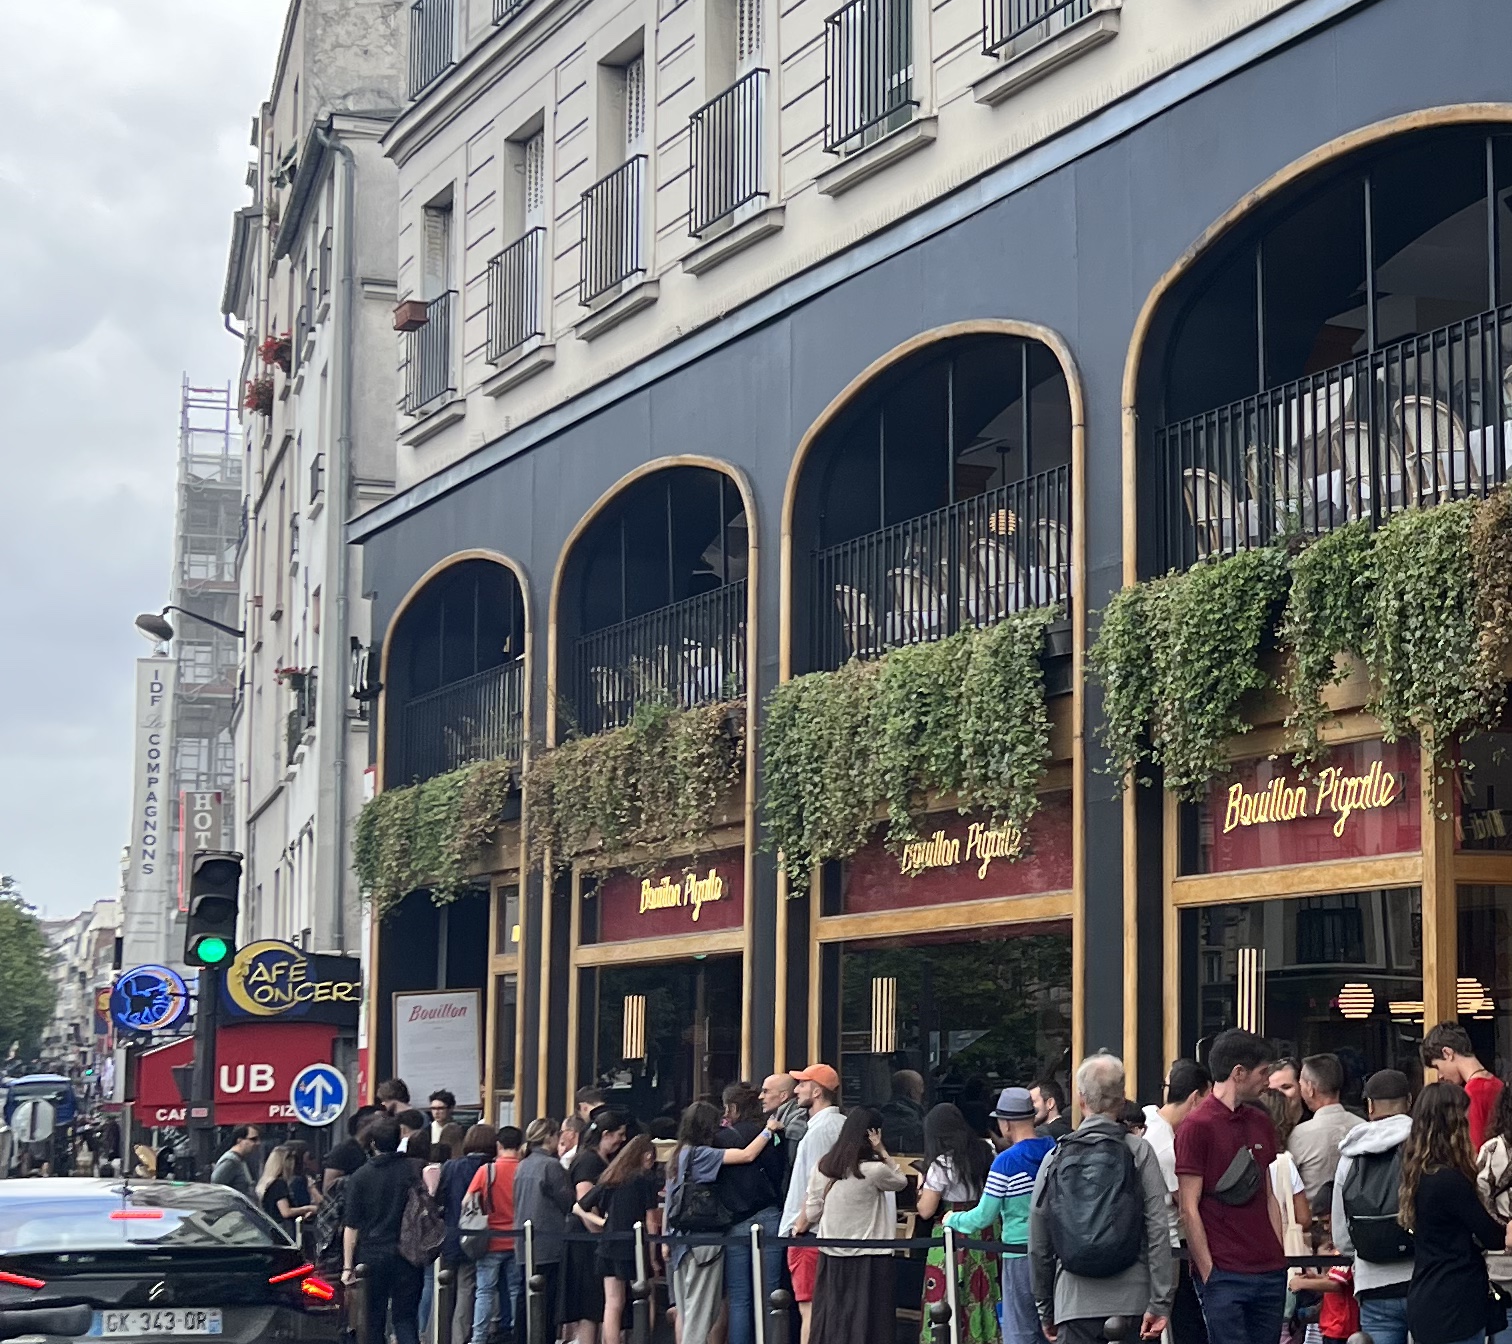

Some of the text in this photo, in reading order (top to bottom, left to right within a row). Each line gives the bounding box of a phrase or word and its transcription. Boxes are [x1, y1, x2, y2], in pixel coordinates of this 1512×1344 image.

[149, 669, 164, 707] IDF
[141, 733, 161, 875] COMPAGNONS
[193, 793, 213, 849] HOT
[1222, 776, 1308, 834] Bouillon
[1316, 760, 1395, 838] Pigalle
[639, 867, 723, 924] Bouillon Pigalle
[408, 1002, 468, 1024] Bouillon
[219, 1064, 276, 1094] UB
[155, 1107, 188, 1122] CAF
[268, 1105, 297, 1118] PIZ
